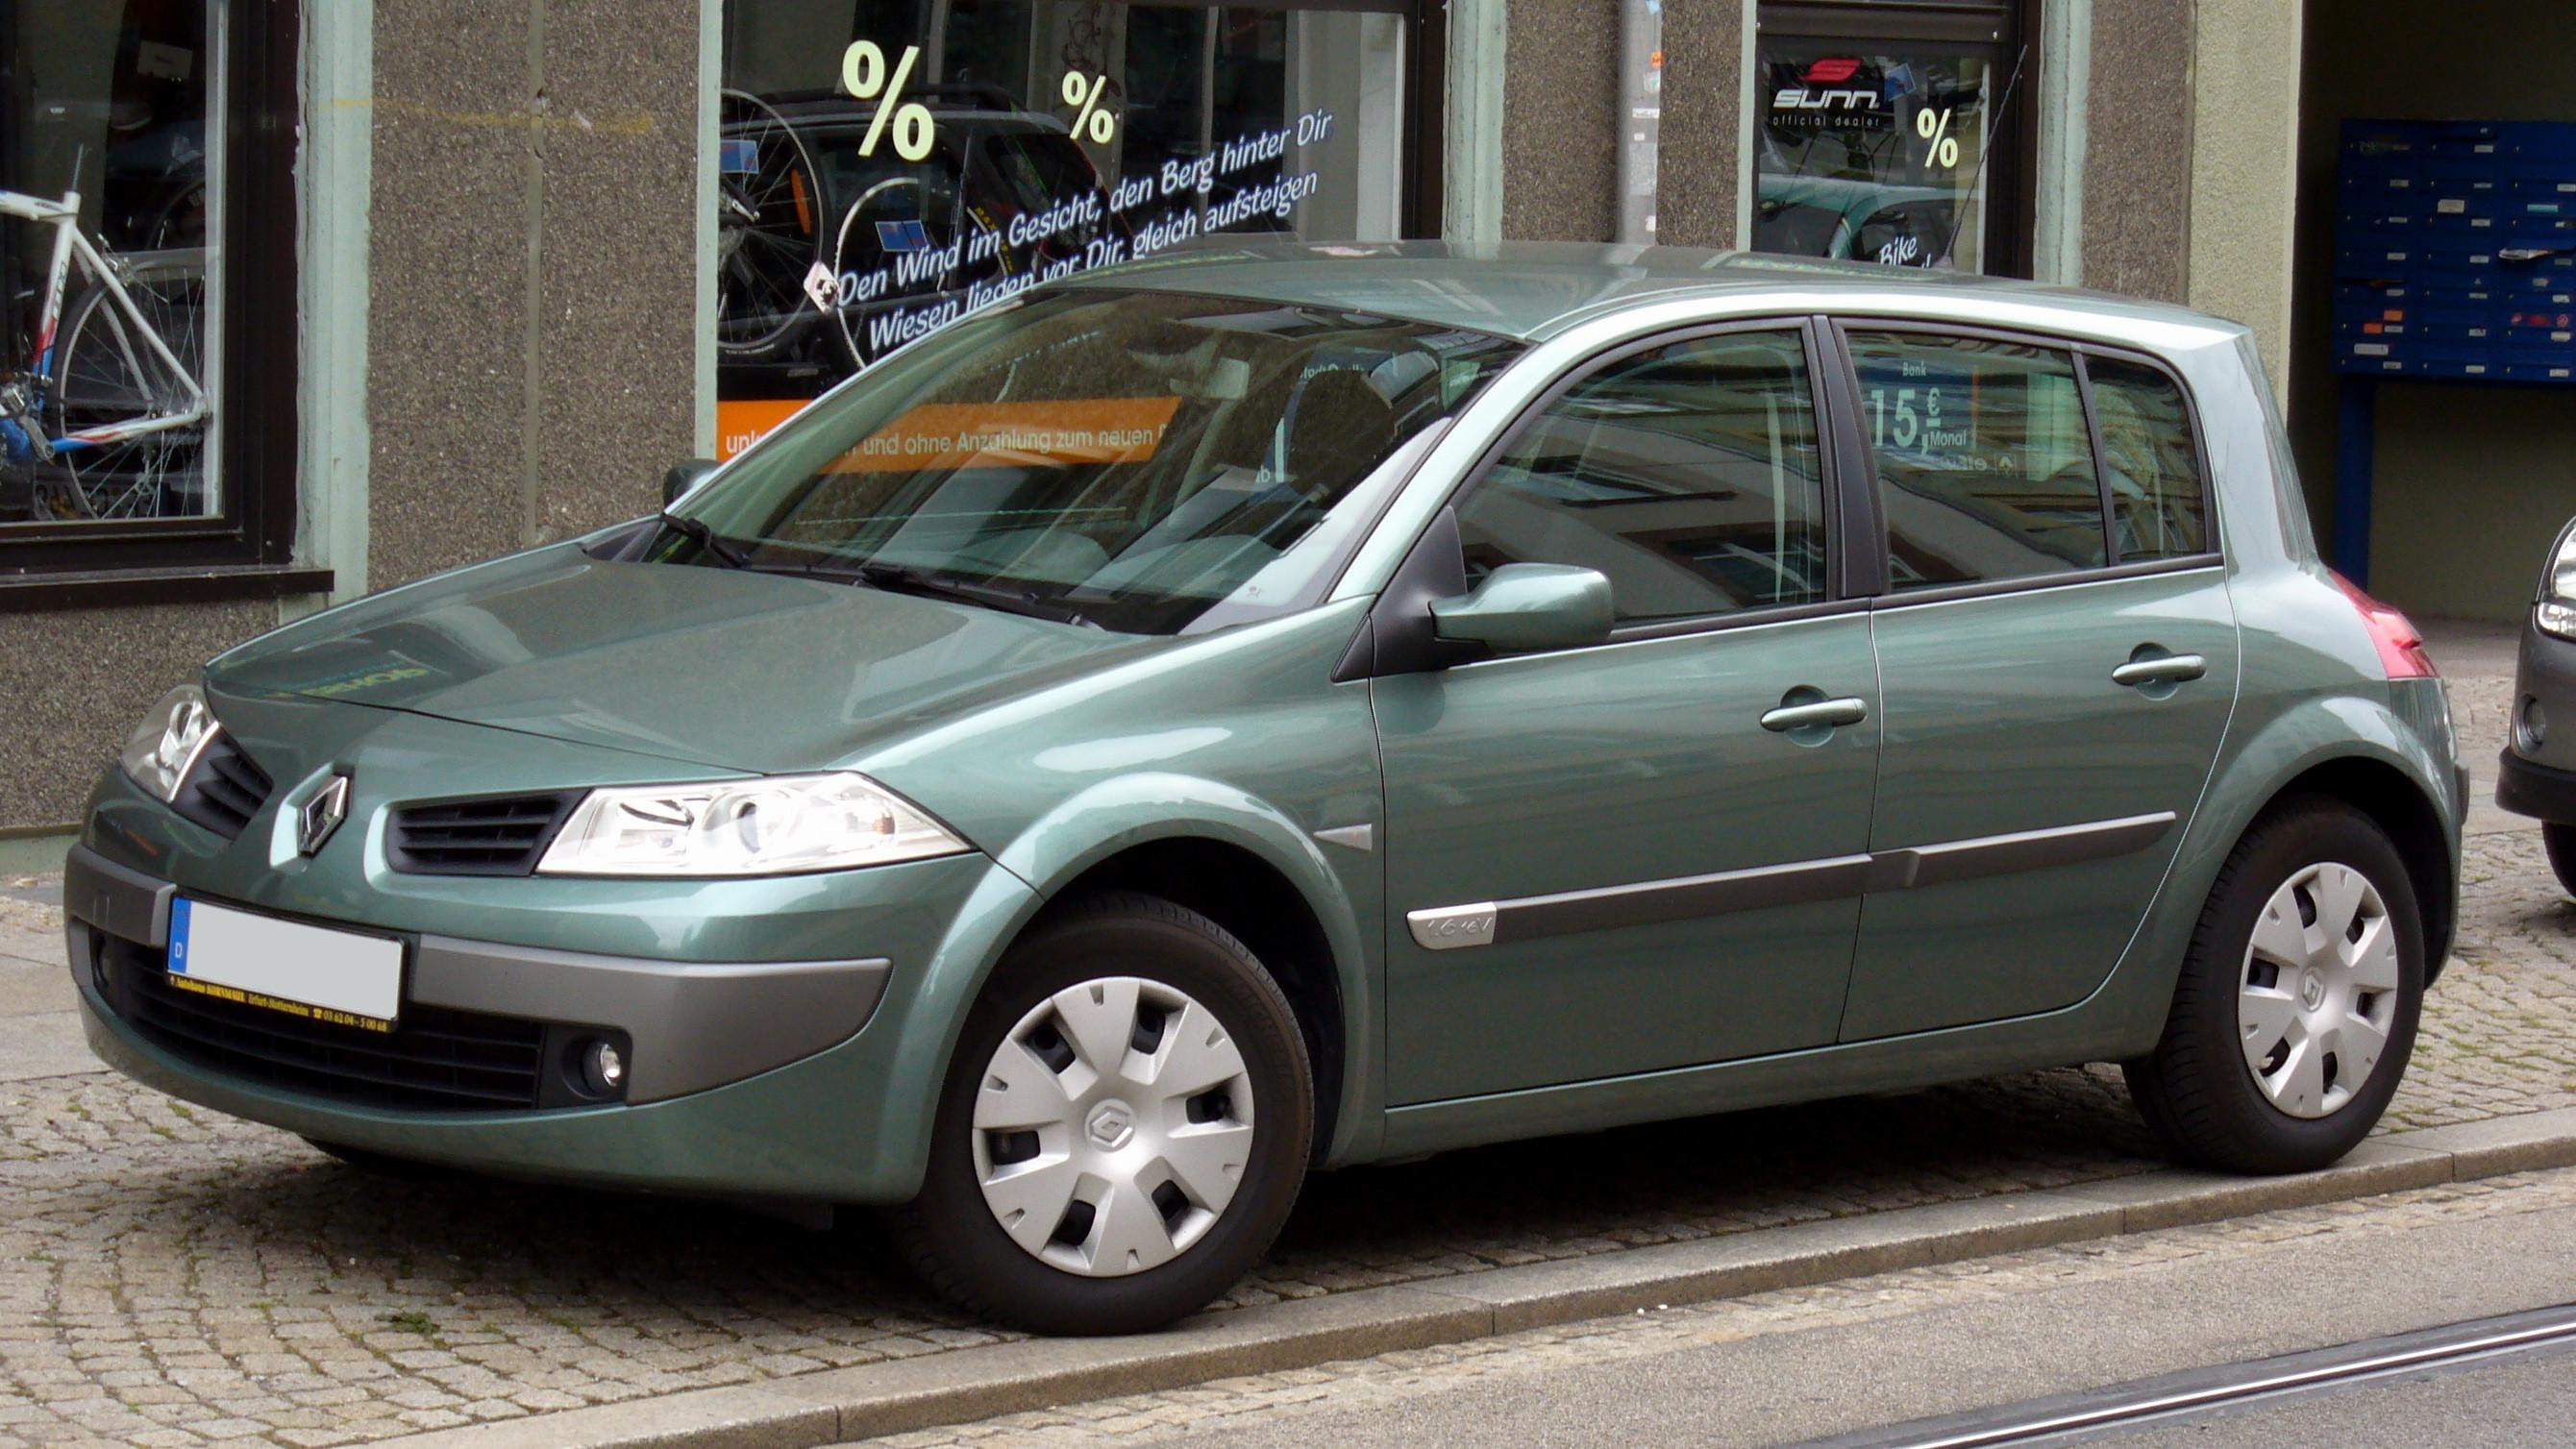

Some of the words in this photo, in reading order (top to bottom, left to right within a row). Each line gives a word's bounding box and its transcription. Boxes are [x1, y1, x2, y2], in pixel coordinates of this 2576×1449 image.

[842, 39, 934, 161] %
[1062, 71, 1114, 143] %
[1772, 114, 1826, 127] official
[1835, 114, 1879, 127] dealer
[1917, 108, 1958, 168] %
[837, 268, 886, 307] Den
[897, 233, 961, 287] Wind
[968, 228, 1001, 264] im
[1009, 191, 1102, 247] Gesicht,
[1110, 177, 1153, 213] den
[1160, 152, 1215, 193] Berg
[1221, 128, 1291, 175] hinter
[1297, 107, 1333, 146] Dir
[870, 299, 957, 352] Wiesen
[1043, 254, 1081, 282] vor
[1132, 209, 1198, 260] gleich
[1203, 171, 1318, 233] aufsteigen
[1879, 235, 1918, 267] Bike
[1902, 361, 1927, 377] Bank
[864, 434, 900, 456] und
[904, 433, 951, 455] ohne
[956, 429, 1052, 454] Anzahlung
[1055, 431, 1093, 448] zum
[1098, 429, 1153, 447] neuen
[174, 942, 183, 959] D
